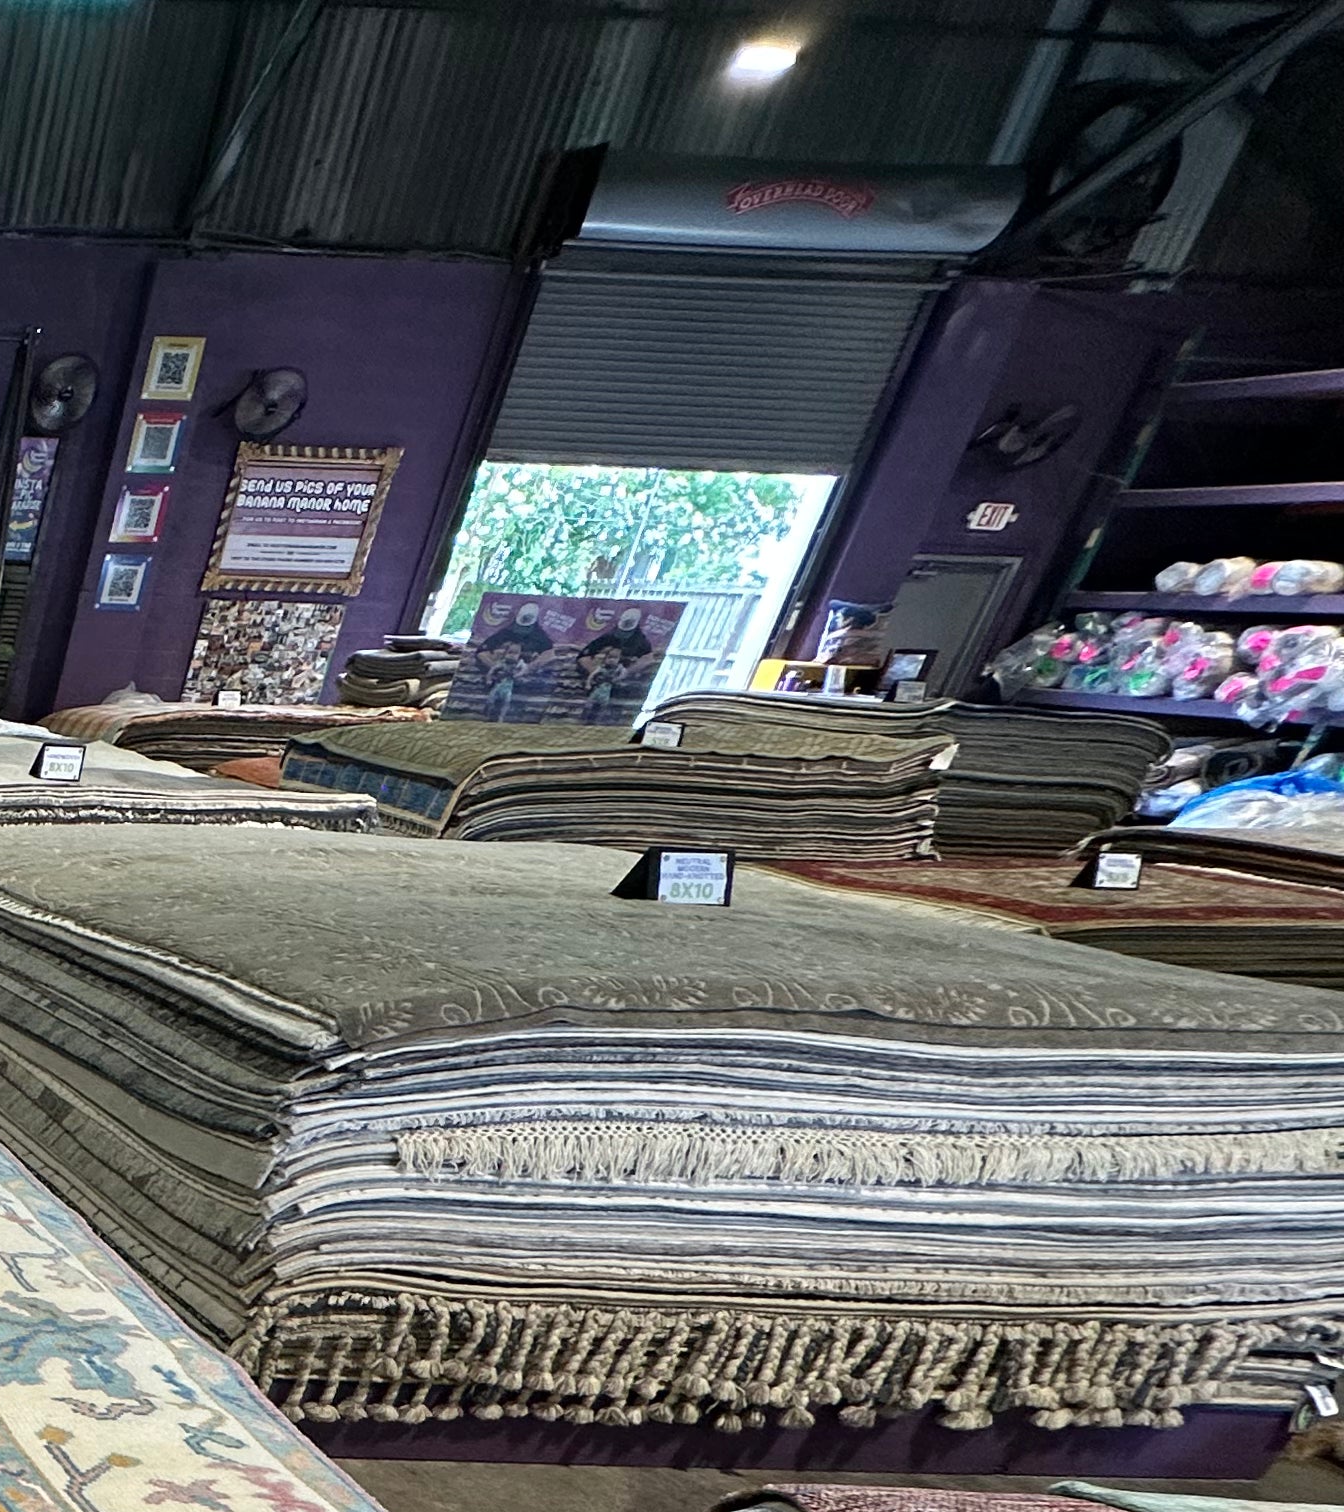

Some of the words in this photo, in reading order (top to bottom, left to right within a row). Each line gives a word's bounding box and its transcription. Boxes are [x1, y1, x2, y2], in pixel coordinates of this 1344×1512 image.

[740, 183, 824, 209] OVERHEAD
[824, 187, 858, 213] DOOR
[275, 480, 292, 494] US
[326, 482, 344, 495] OF
[347, 483, 377, 497] YOUR
[976, 505, 1010, 529] EXIT
[48, 762, 75, 773] 8X10
[675, 857, 712, 865] NEUTRAL
[669, 882, 714, 899] 8X10
